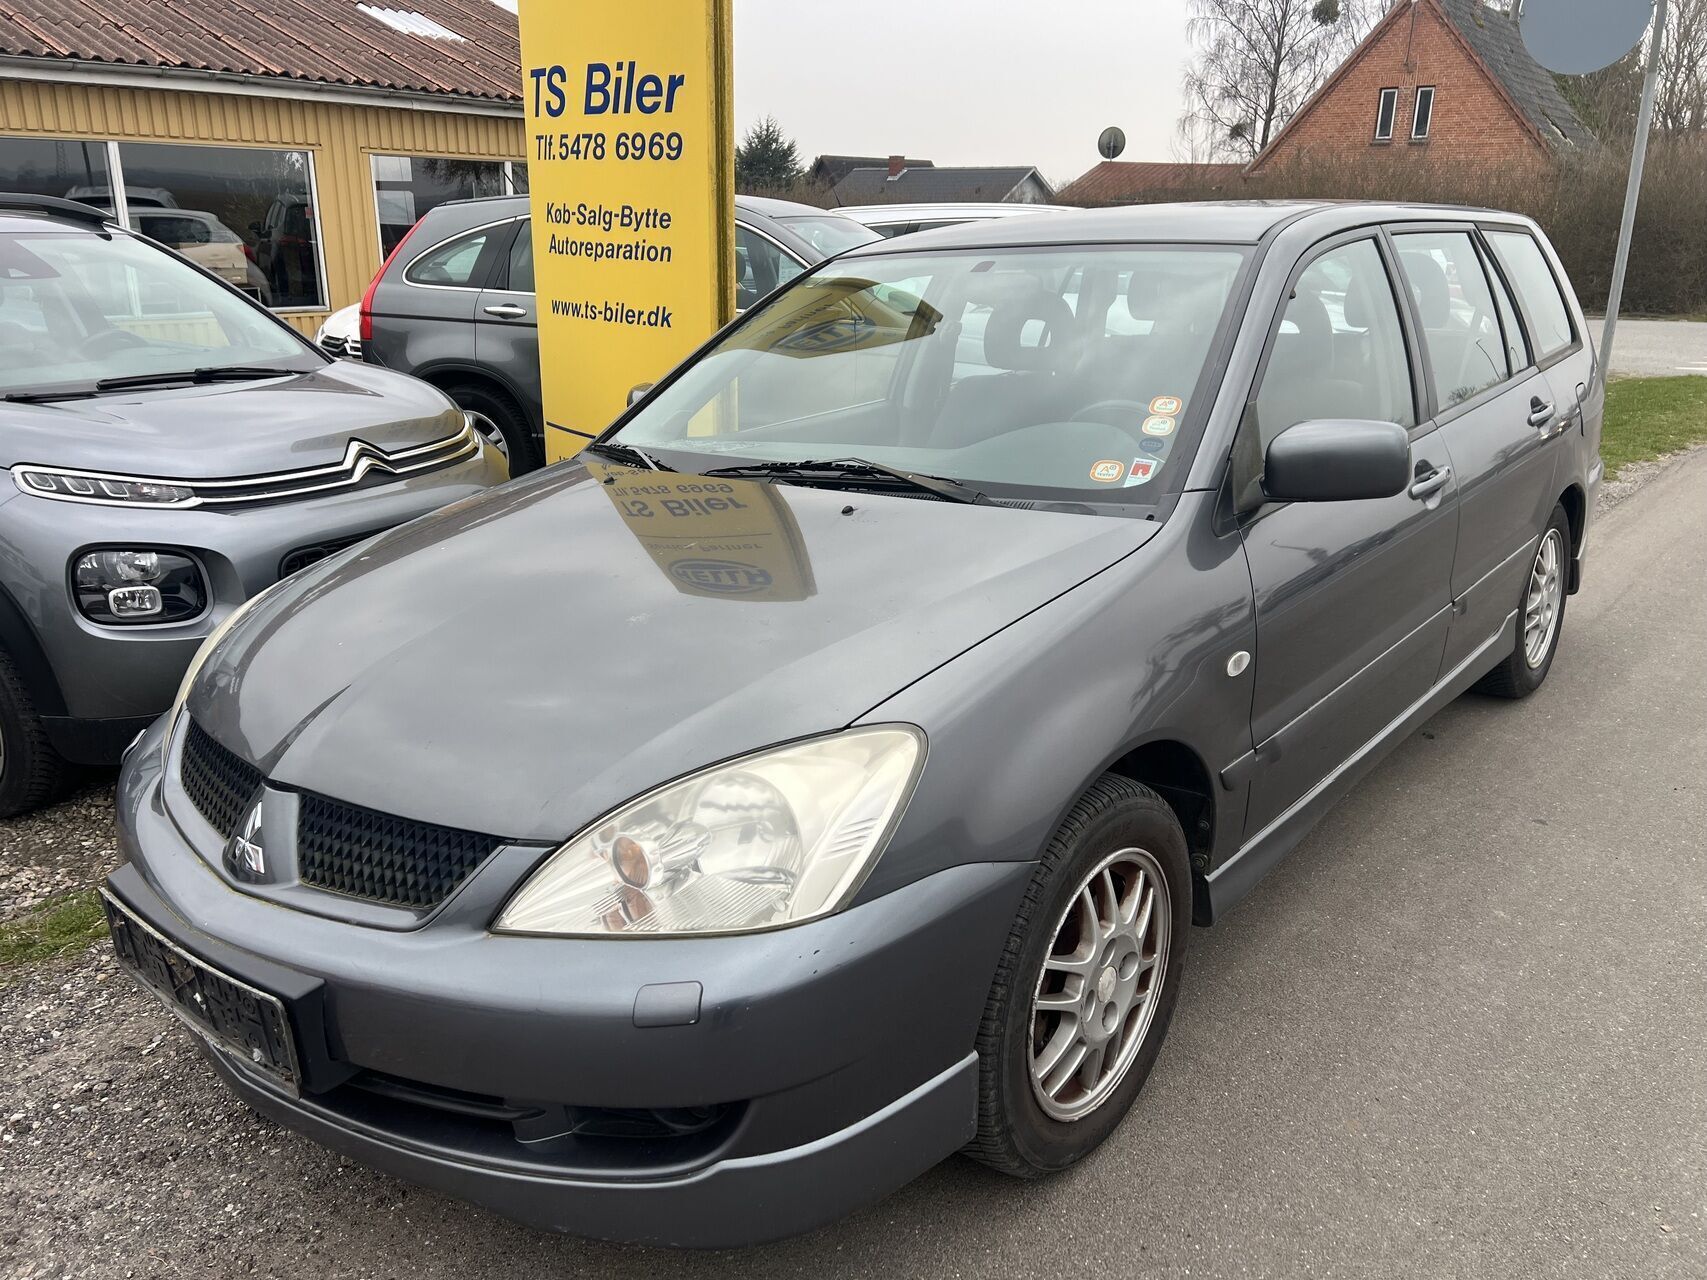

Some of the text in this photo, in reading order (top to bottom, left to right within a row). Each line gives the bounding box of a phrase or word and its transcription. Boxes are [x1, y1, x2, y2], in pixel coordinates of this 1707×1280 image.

[530, 61, 685, 118] TS Biler
[615, 131, 684, 161] 6969
[546, 202, 672, 231] Køb-Salg-Bytte
[549, 234, 672, 262] Autoreparation
[551, 299, 672, 328] www.ts-biler.dk
